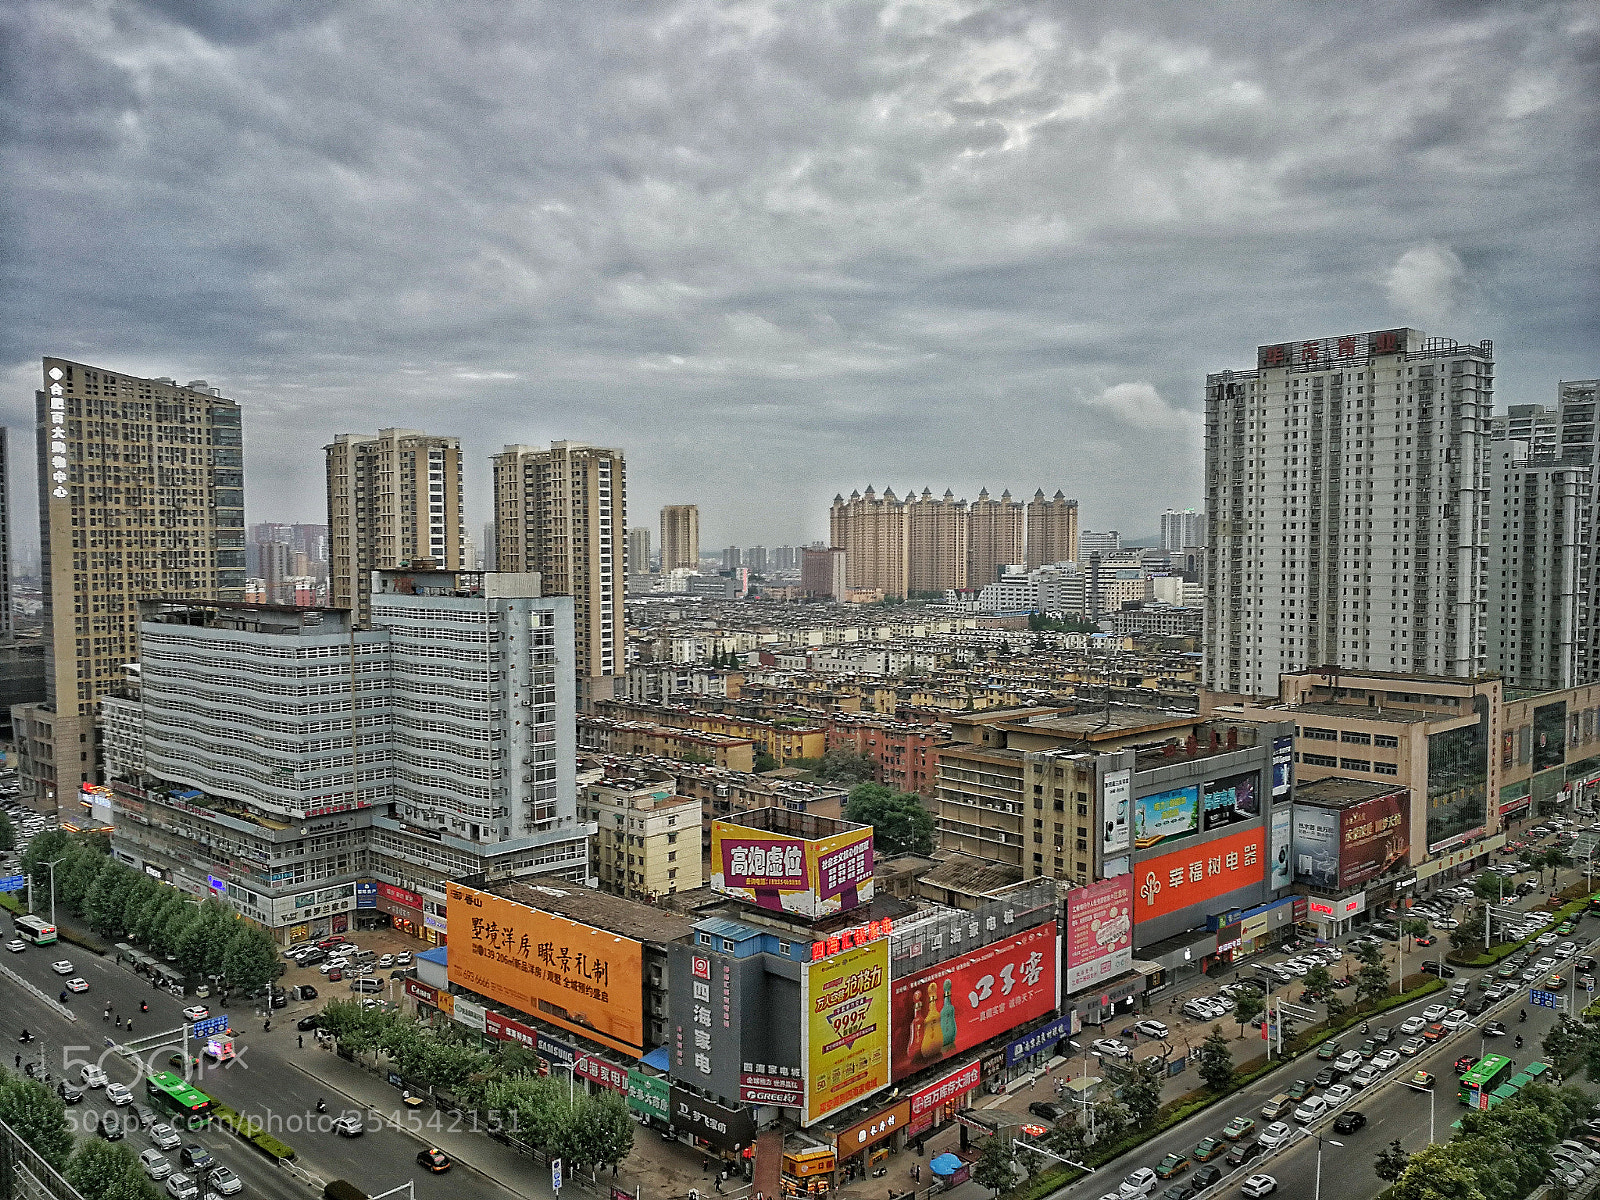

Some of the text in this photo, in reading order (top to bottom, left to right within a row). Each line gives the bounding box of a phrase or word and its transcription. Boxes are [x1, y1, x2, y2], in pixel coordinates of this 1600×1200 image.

[730, 845, 803, 877] 高炮虚位
[1168, 843, 1258, 888] 幸福树电器
[471, 917, 609, 988] 墅境洋房 瞰景礼制
[968, 950, 1044, 1009] 口子窖
[692, 980, 712, 1075] 四海家电
[537, 1039, 573, 1064] SAMSUNG
[923, 1067, 979, 1108] 百万库存大清仓
